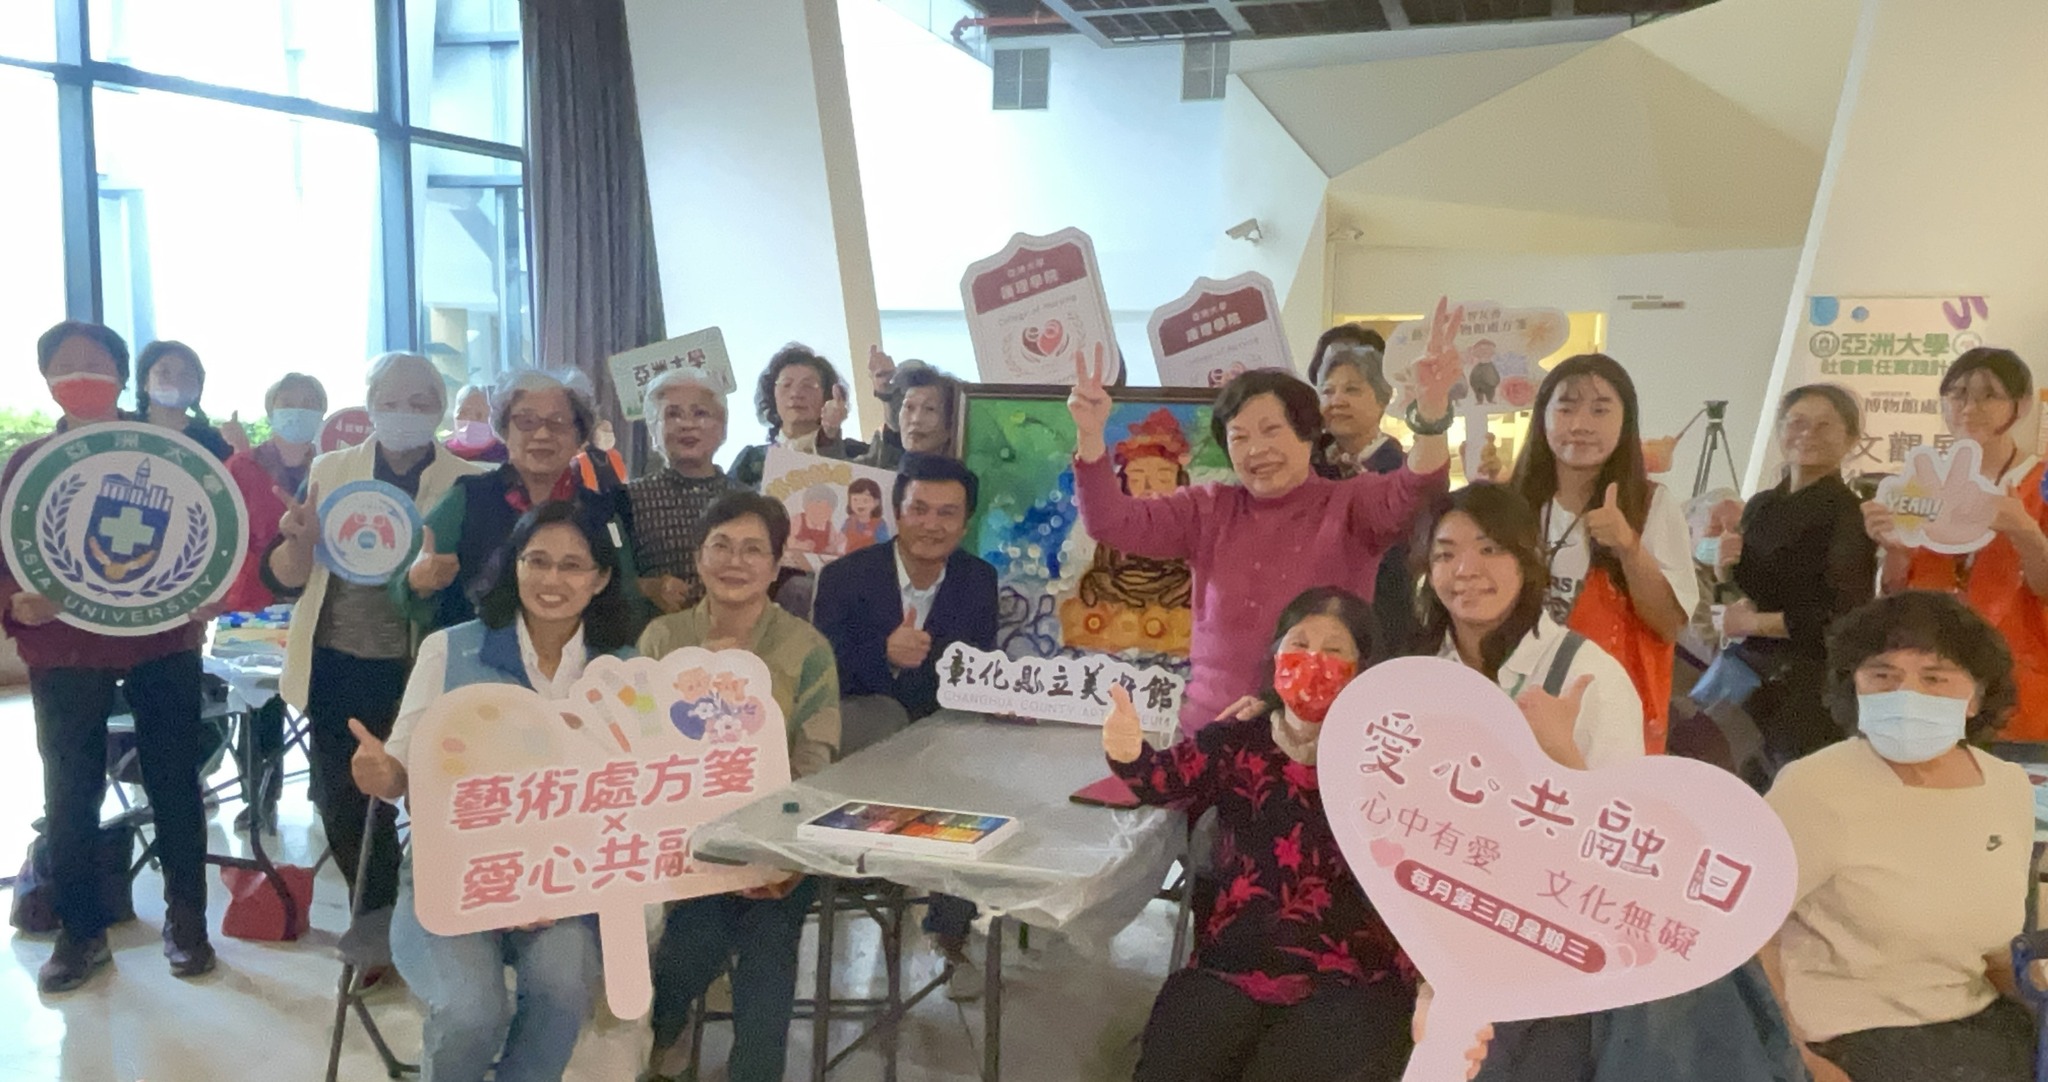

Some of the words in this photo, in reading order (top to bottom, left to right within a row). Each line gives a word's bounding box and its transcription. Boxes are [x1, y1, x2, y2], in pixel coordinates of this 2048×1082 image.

[1820, 359, 1953, 376] 社會責任實踐計
[1839, 332, 1950, 357] 亞洲大學
[1864, 398, 1942, 415] 博物館處
[18, 538, 52, 591] ASIA
[62, 574, 213, 623] UNIVERSITY
[450, 746, 758, 831] 藝術處方箋
[1359, 711, 1752, 914] 愛心共融日
[1359, 790, 1502, 876] 心中有愛
[1536, 868, 1702, 962] 文化無礙
[1408, 866, 1592, 967] 每月第三周星期三
